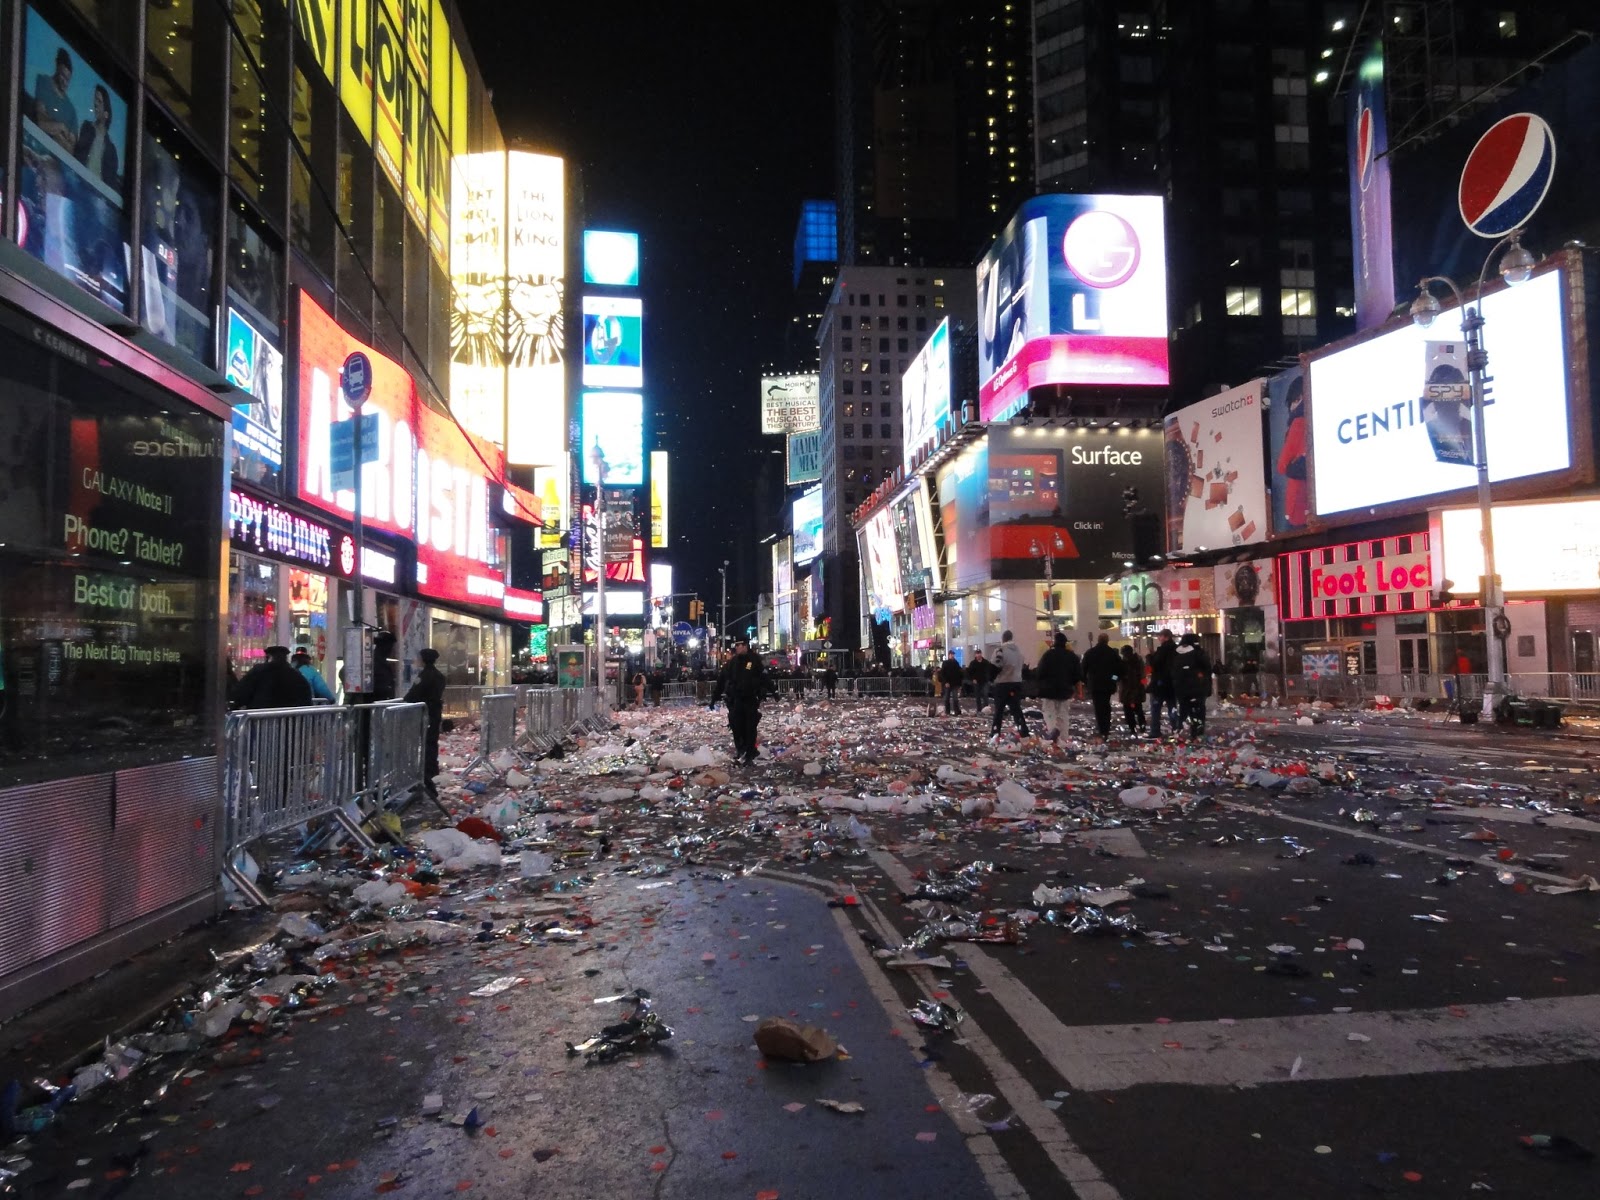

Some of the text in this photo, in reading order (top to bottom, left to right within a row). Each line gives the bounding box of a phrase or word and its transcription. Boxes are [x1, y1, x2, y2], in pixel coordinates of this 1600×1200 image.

[514, 226, 558, 247] KING
[1428, 385, 1464, 398] SPY
[767, 407, 816, 417] THE BEST
[1211, 396, 1247, 418] swatch
[766, 415, 803, 423] MUSICAL
[1071, 445, 1143, 465] Surface
[82, 467, 135, 502] GALAXY
[136, 486, 162, 512] Note
[1074, 522, 1089, 530] Click
[64, 513, 183, 567] Phone? Tablet?
[1312, 565, 1367, 598] Foot
[74, 574, 174, 614] Best of both.
[62, 642, 83, 659] The
[84, 643, 109, 660] Next
[110, 645, 127, 664] Big
[128, 645, 152, 665] Thing
[153, 648, 161, 662] Is
